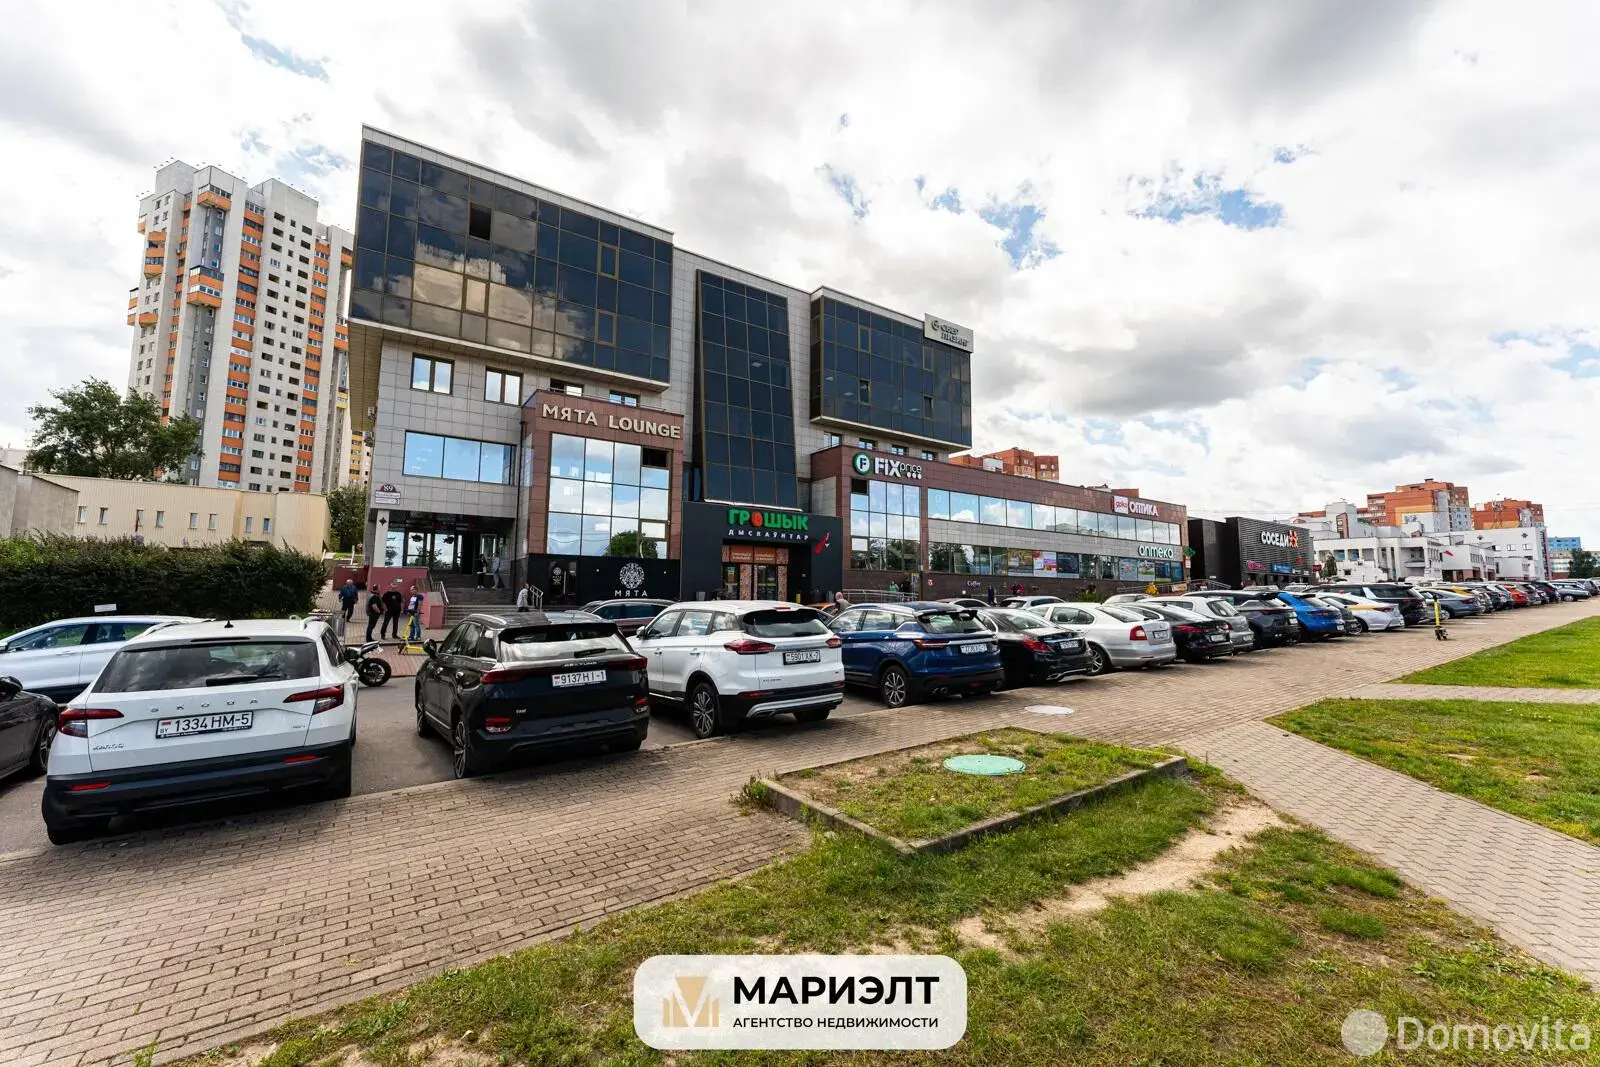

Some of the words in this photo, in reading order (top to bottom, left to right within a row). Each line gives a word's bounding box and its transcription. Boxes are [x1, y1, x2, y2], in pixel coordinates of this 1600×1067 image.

[542, 403, 598, 426] МЯТА
[608, 415, 681, 439] LOUNGE
[1129, 501, 1159, 517] ОПТИКА
[728, 508, 809, 531] ГРОШЫК
[1261, 530, 1289, 548] СОСЕДИ
[1139, 545, 1174, 559] аптека
[561, 673, 581, 685] 9137
[174, 717, 208, 732] 1334
[211, 713, 250, 728] HM-5
